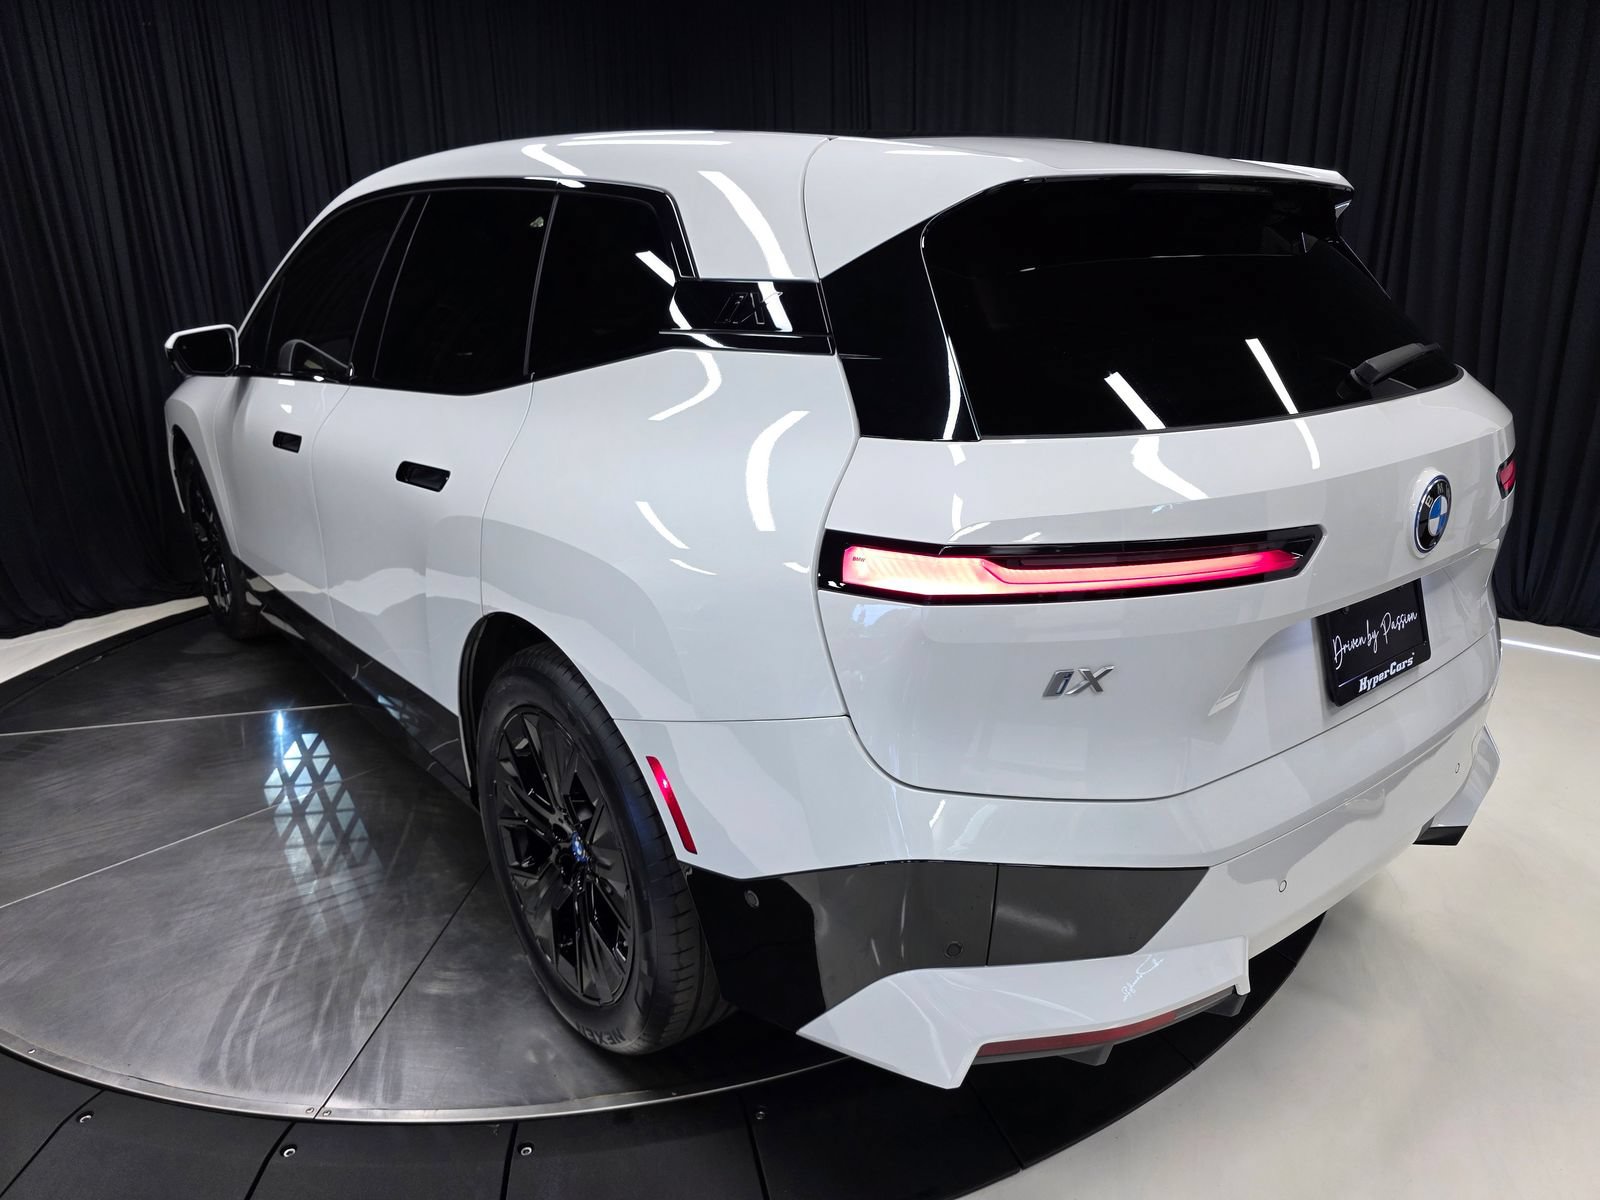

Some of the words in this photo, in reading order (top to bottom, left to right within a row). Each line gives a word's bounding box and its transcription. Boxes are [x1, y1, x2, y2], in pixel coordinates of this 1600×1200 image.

[1424, 481, 1450, 508] BMW
[1332, 635, 1366, 670] Driven
[1366, 619, 1380, 654] by
[1380, 612, 1418, 644] Passion
[1358, 655, 1415, 693] HyperCars
